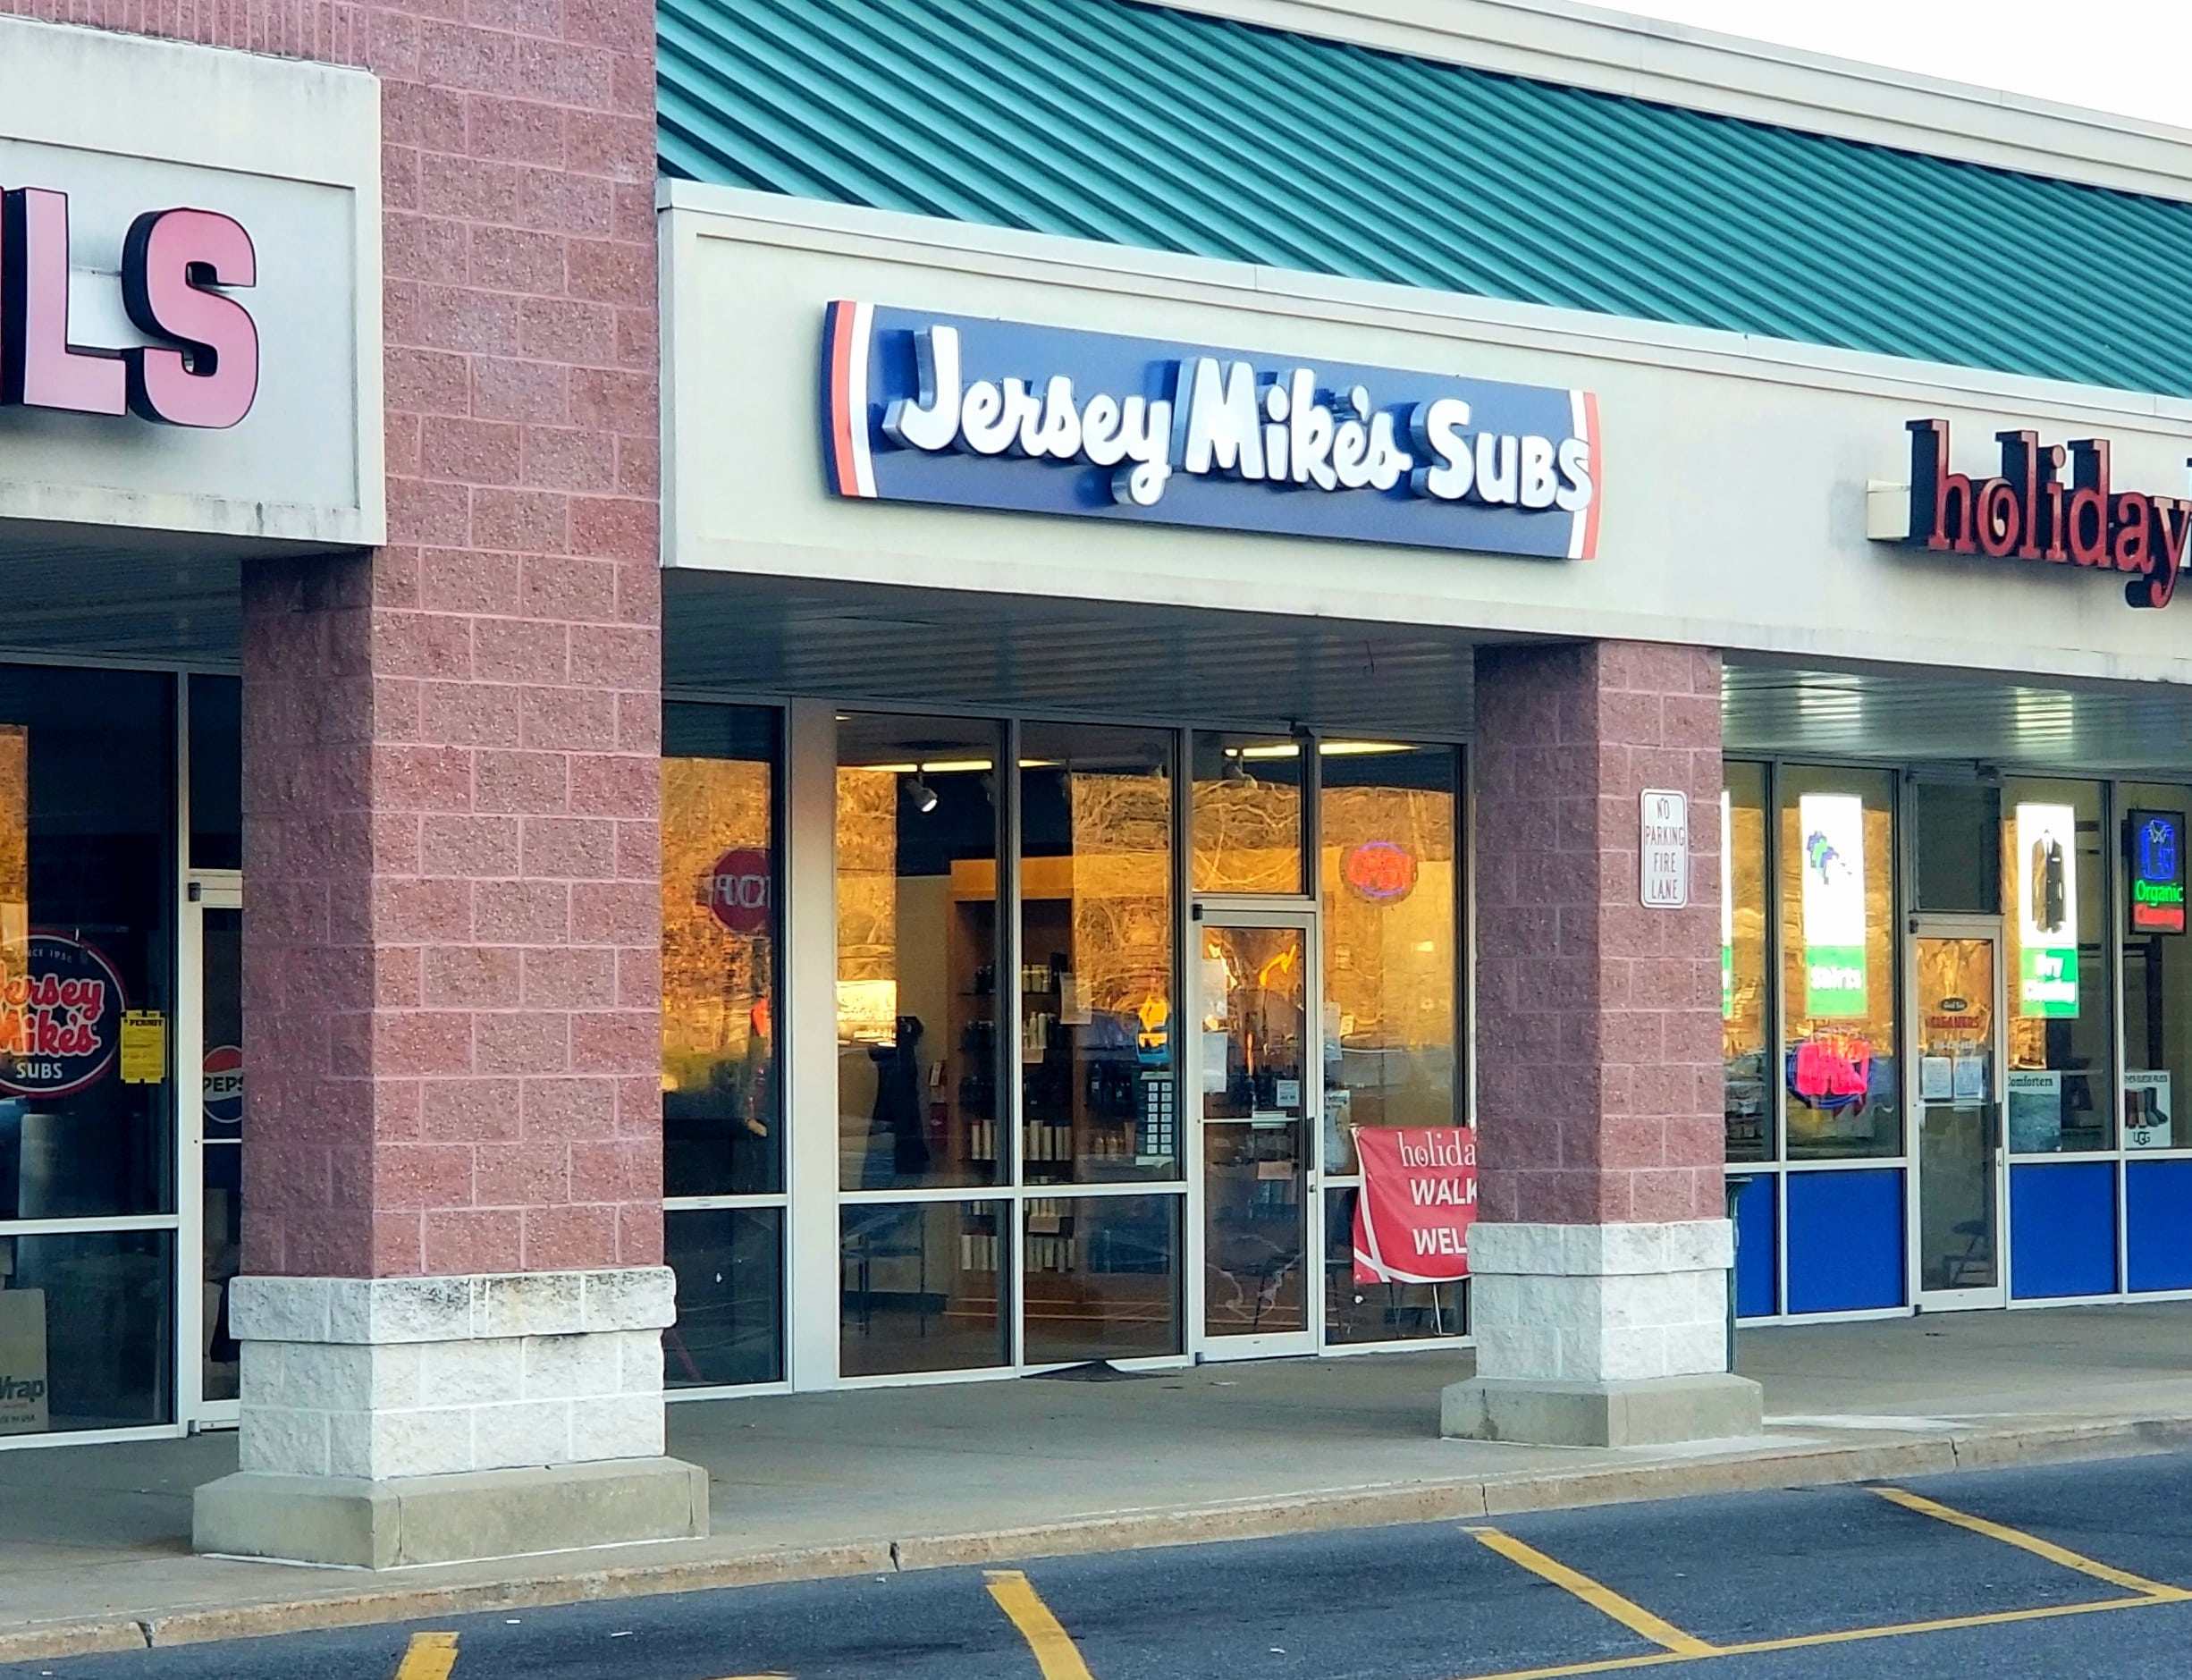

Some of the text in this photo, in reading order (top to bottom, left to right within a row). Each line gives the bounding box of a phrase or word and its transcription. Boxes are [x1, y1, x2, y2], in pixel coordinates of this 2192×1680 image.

[0, 186, 258, 429] LS
[882, 325, 1172, 507] Jersey
[1178, 357, 1413, 492] Mike's
[1905, 418, 2192, 609] holiday
[1657, 798, 1670, 820] NO
[1645, 825, 1685, 847] PARKING
[1654, 852, 1676, 874] FIRE
[1651, 879, 1678, 900] LANE
[2136, 879, 2184, 908] Organic
[0, 958, 105, 1022] ersey
[16, 1062, 63, 1080] SUBS
[203, 1076, 244, 1093] PEPS
[1397, 1130, 1477, 1168] holida
